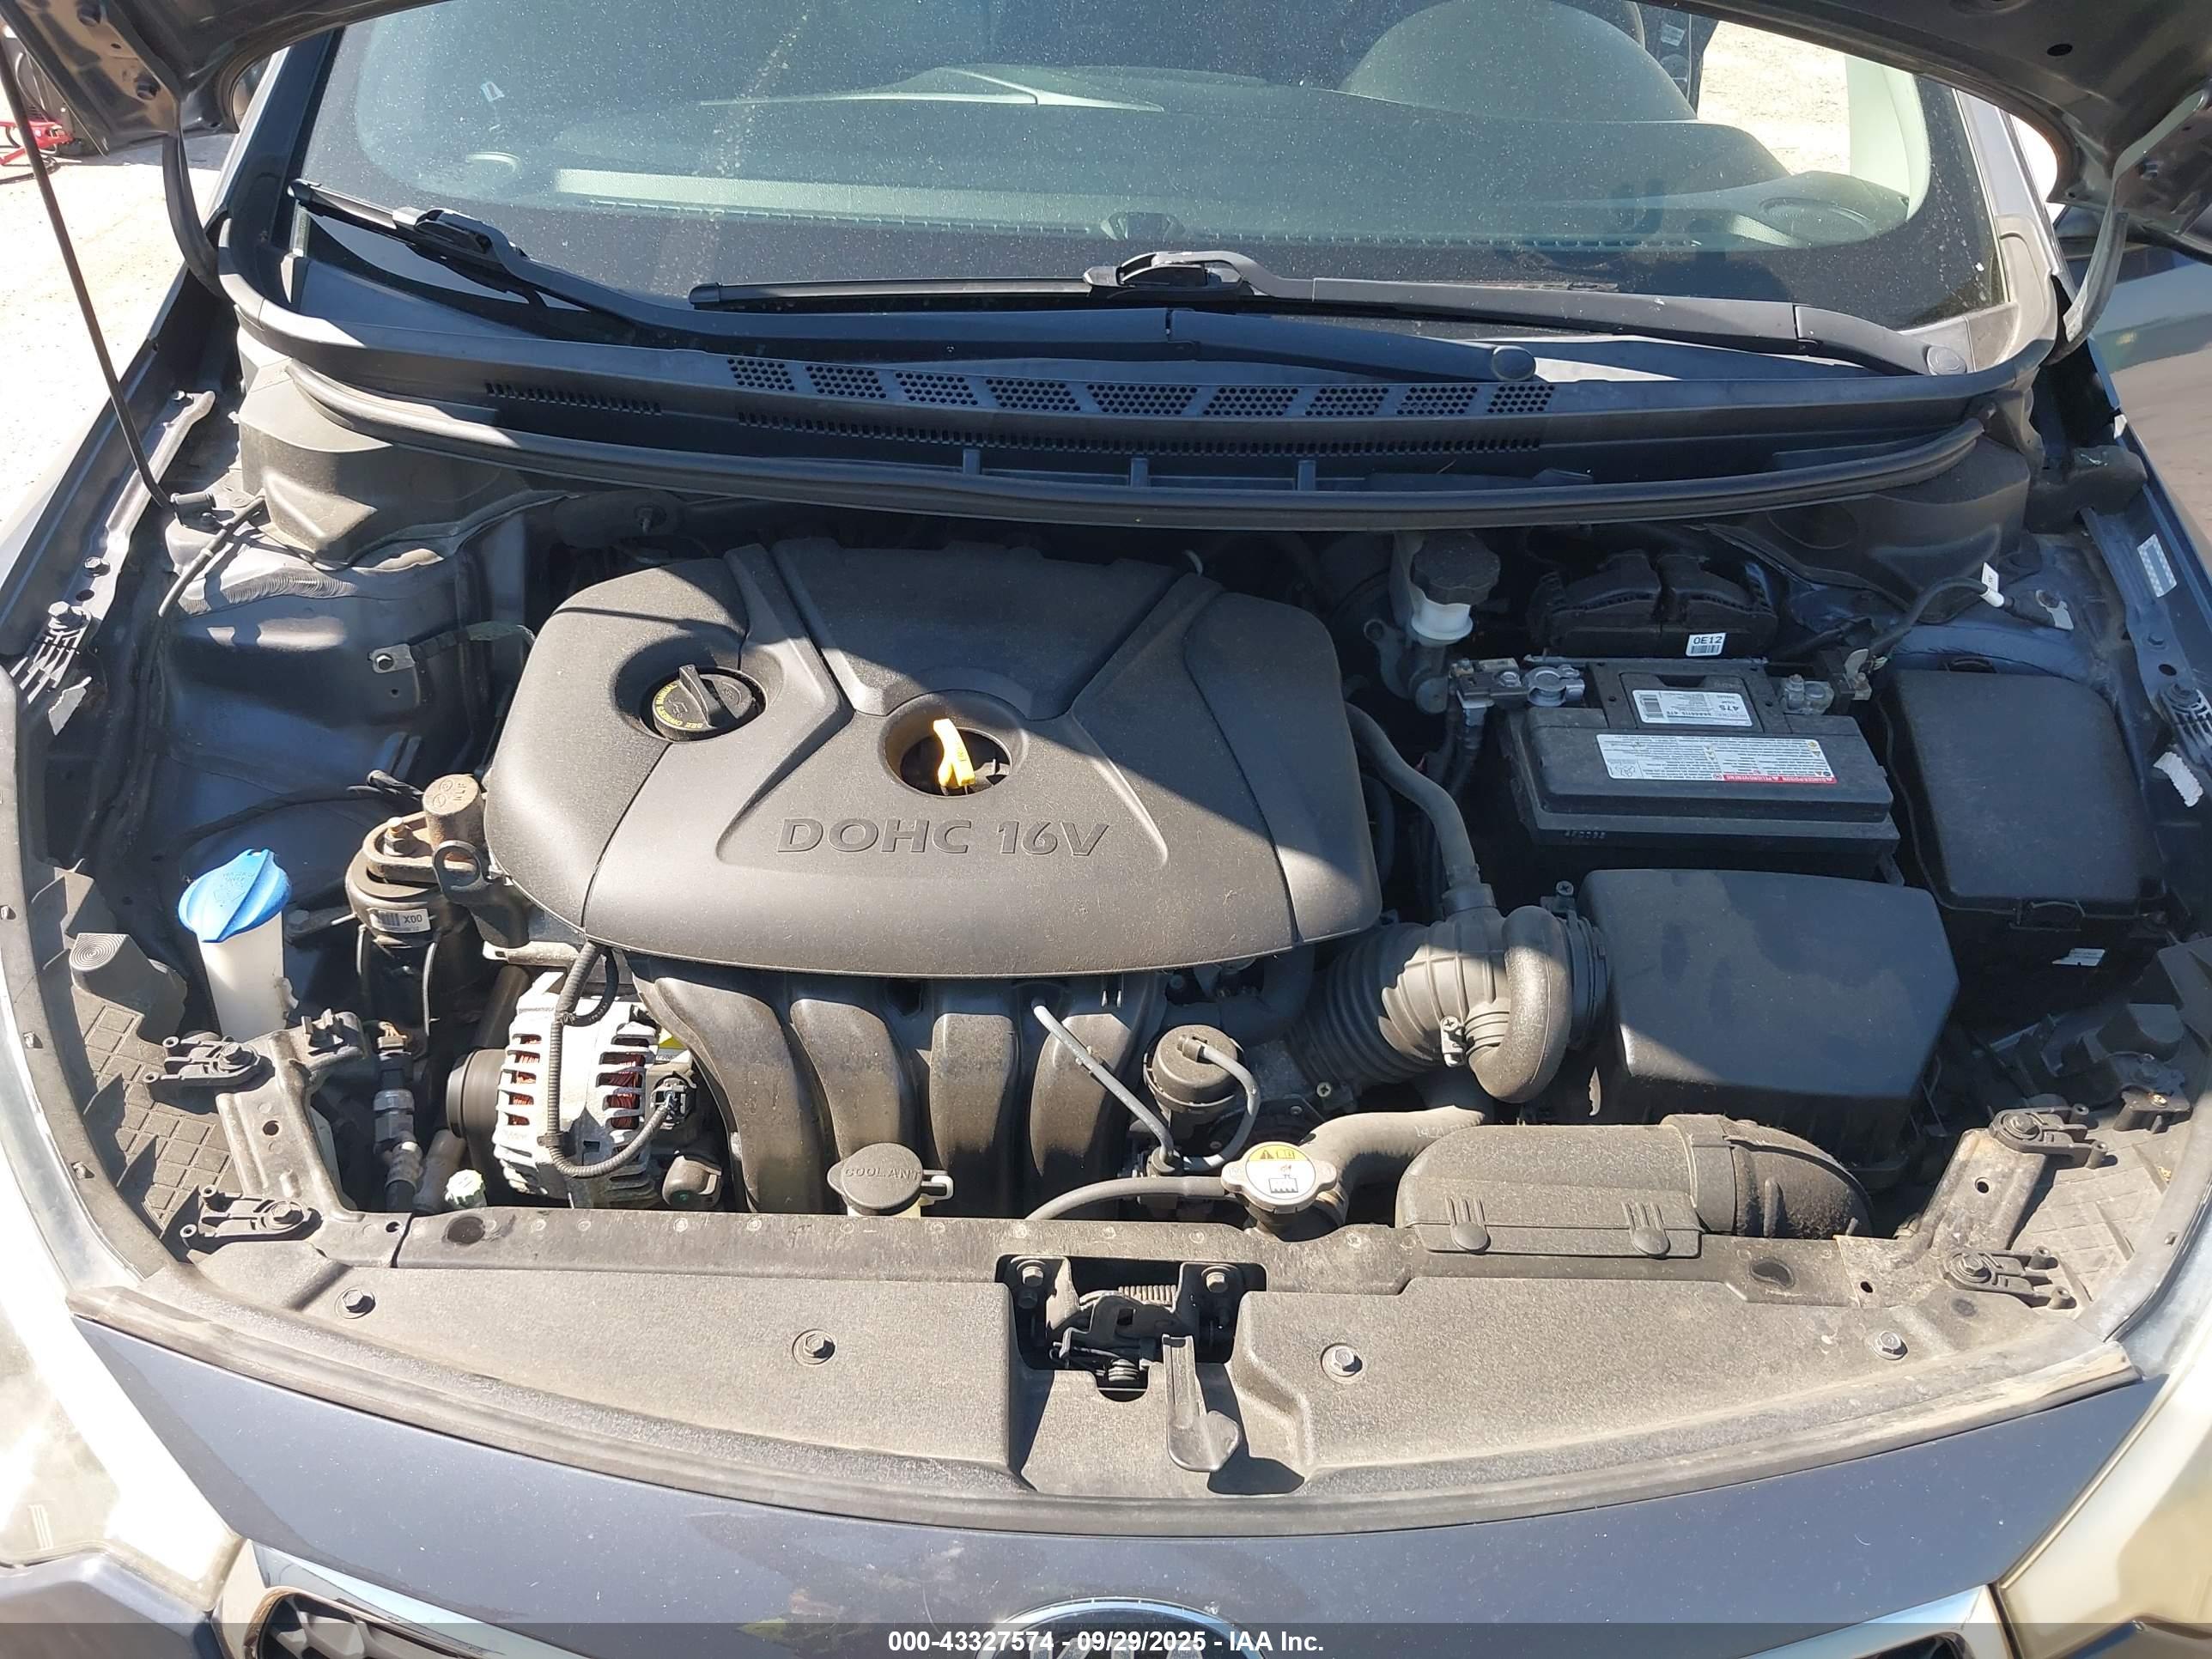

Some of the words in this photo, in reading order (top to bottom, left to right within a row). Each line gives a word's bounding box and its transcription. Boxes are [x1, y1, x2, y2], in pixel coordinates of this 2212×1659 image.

[777, 817, 972, 854] DOHC
[998, 820, 1109, 856] 16V
[844, 1168, 921, 1181] COOLANT
